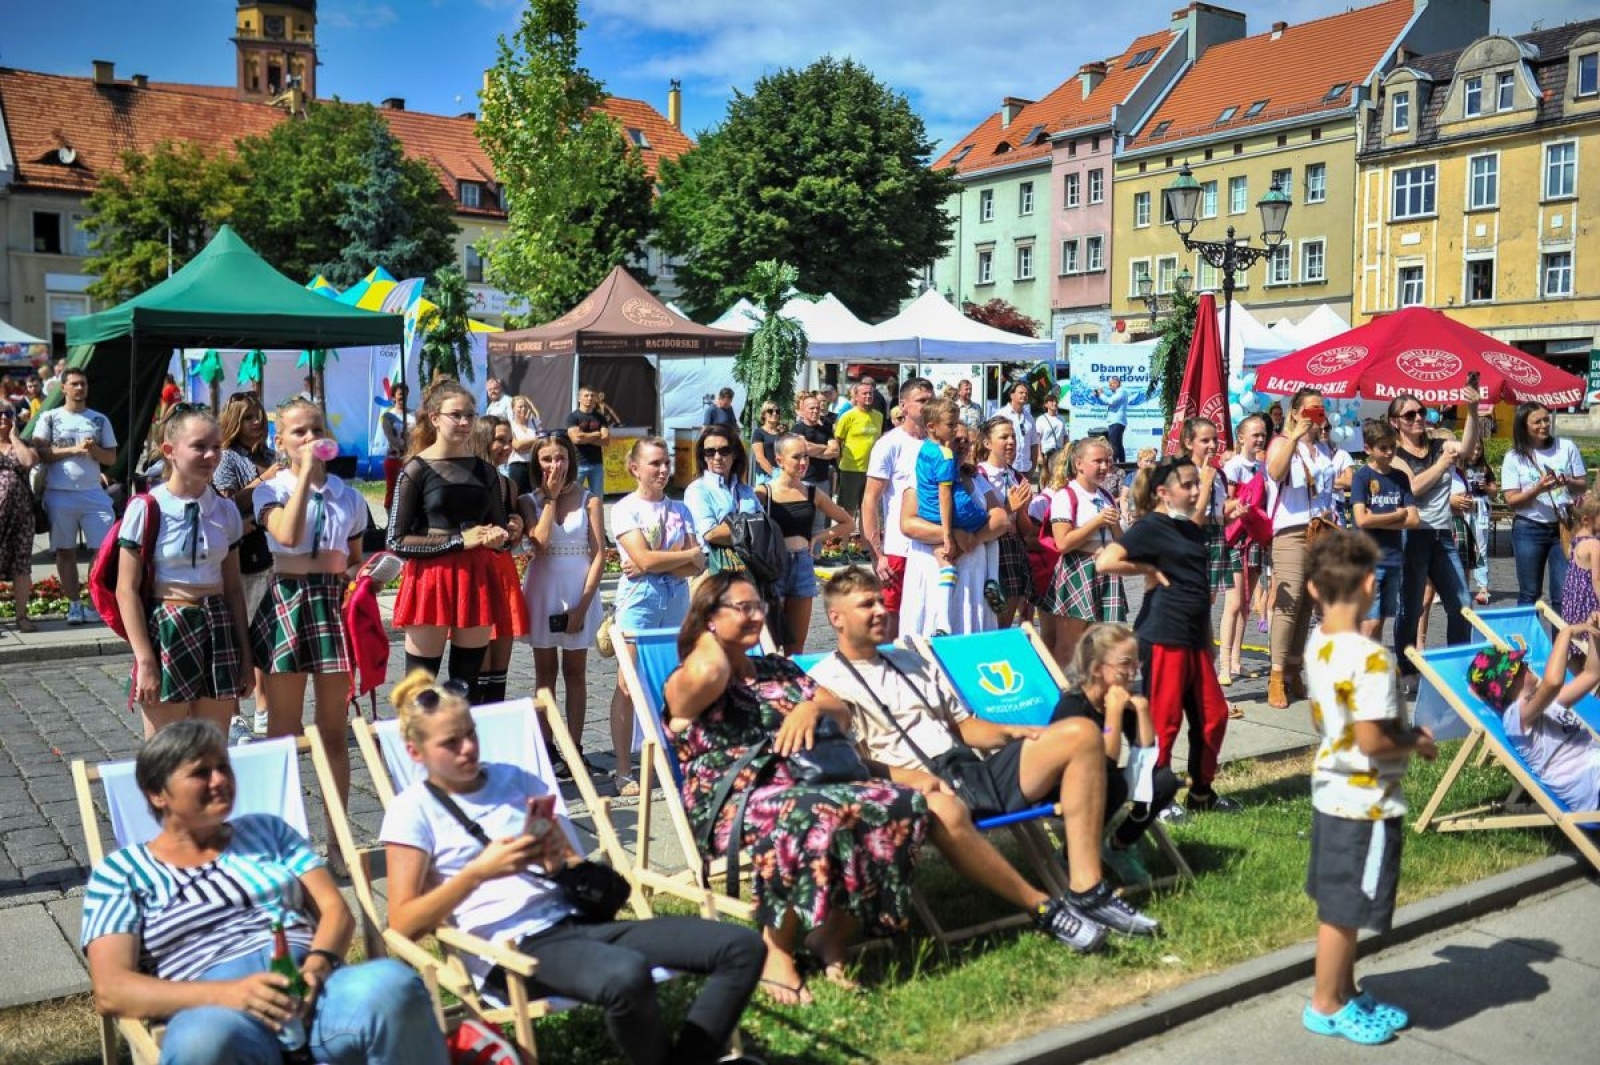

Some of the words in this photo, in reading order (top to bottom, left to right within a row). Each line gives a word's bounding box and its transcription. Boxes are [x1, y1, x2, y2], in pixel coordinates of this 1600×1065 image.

[1091, 363, 1134, 374] Dbamy
[1138, 365, 1146, 373] o
[1375, 383, 1489, 402] RACIBORSE
